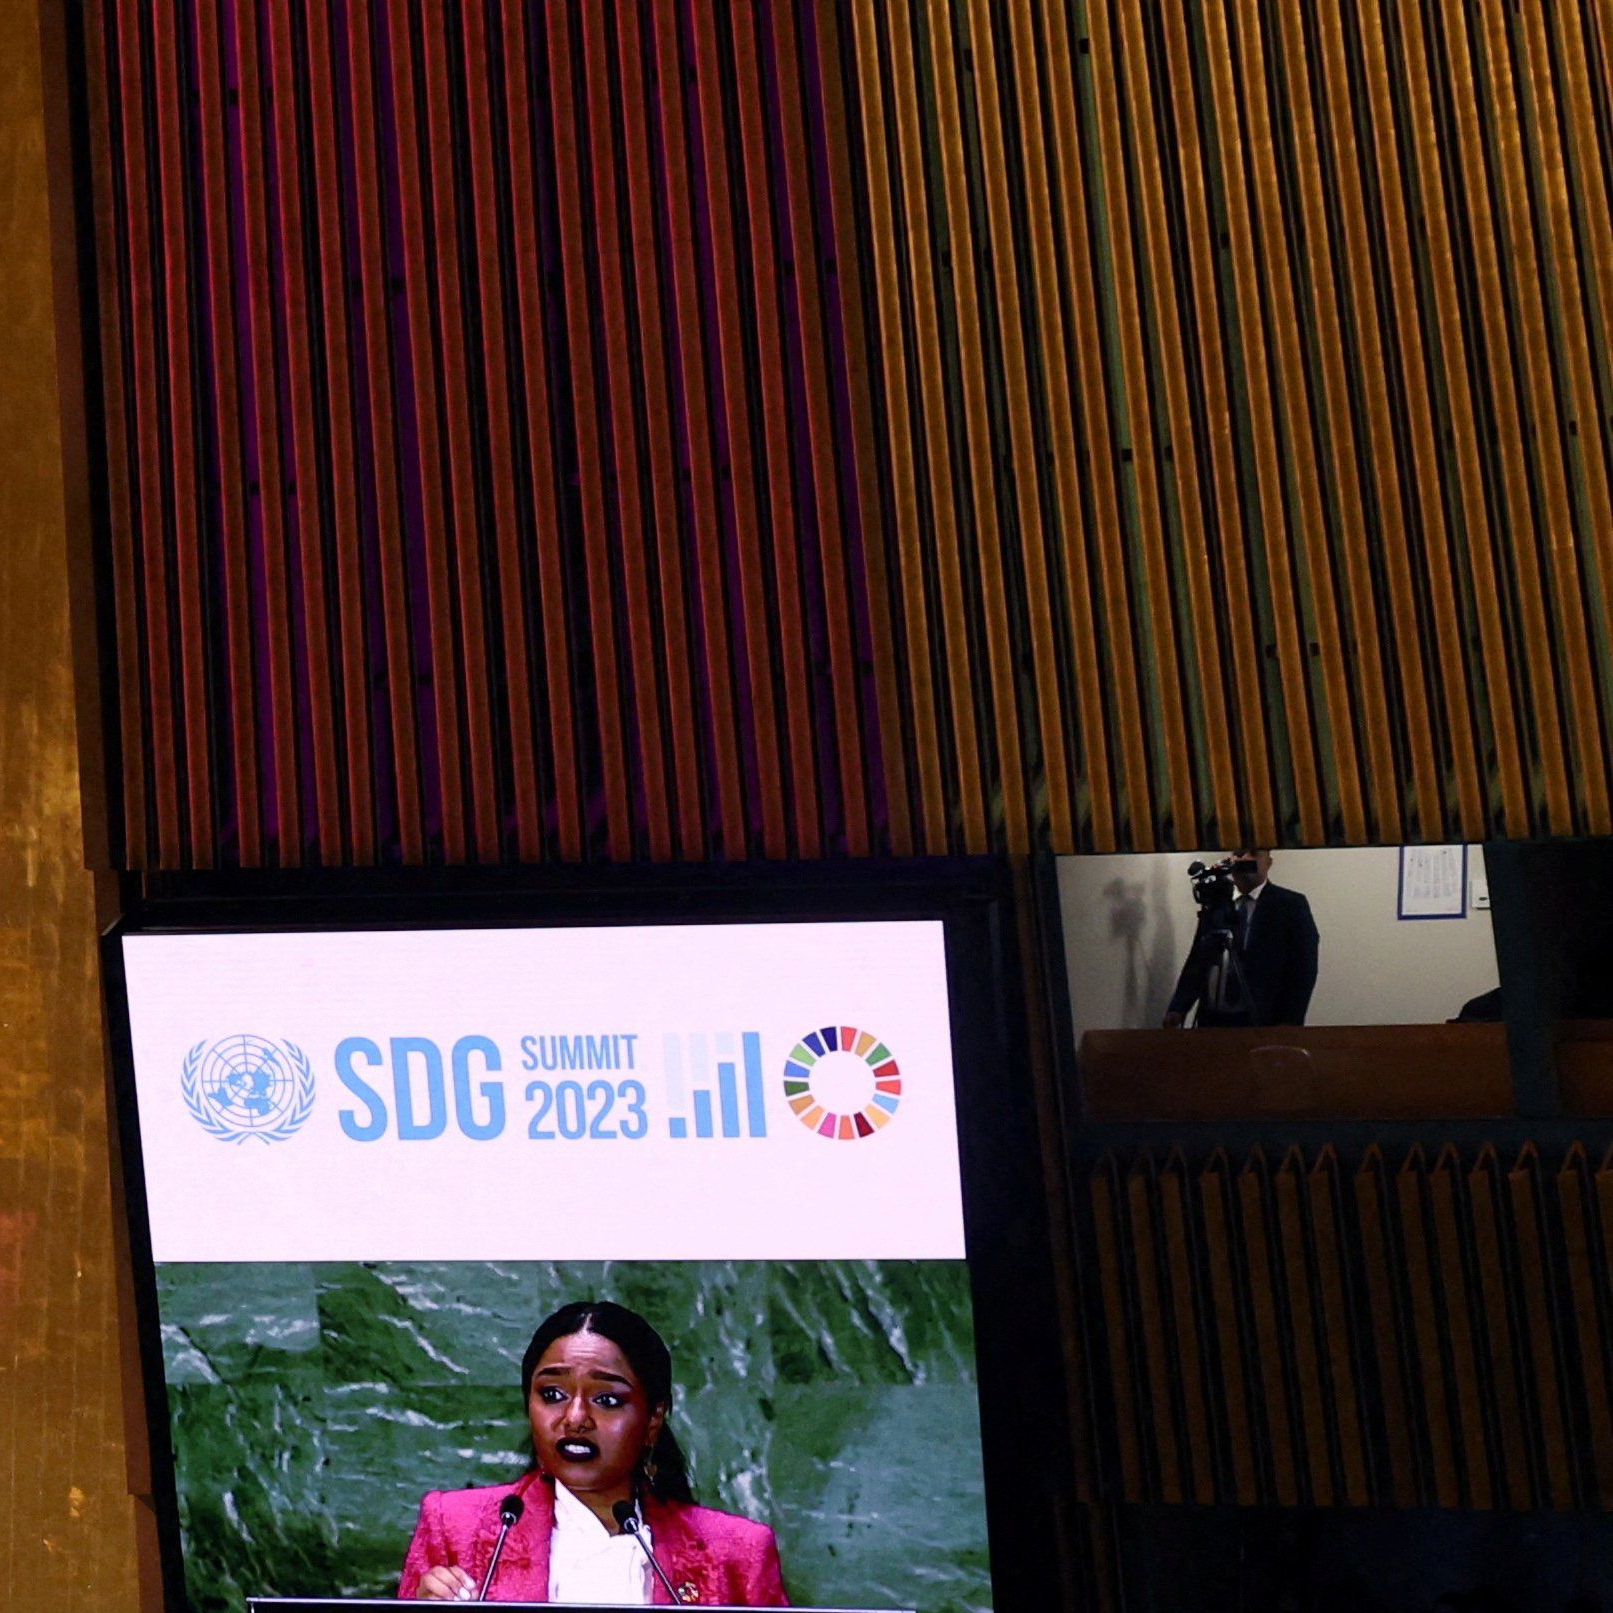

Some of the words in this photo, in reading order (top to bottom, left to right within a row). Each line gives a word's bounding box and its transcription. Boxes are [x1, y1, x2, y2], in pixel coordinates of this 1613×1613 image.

[520, 1033, 638, 1071] SUMMIT
[334, 1034, 507, 1143] SDG
[525, 1079, 649, 1141] 2023
